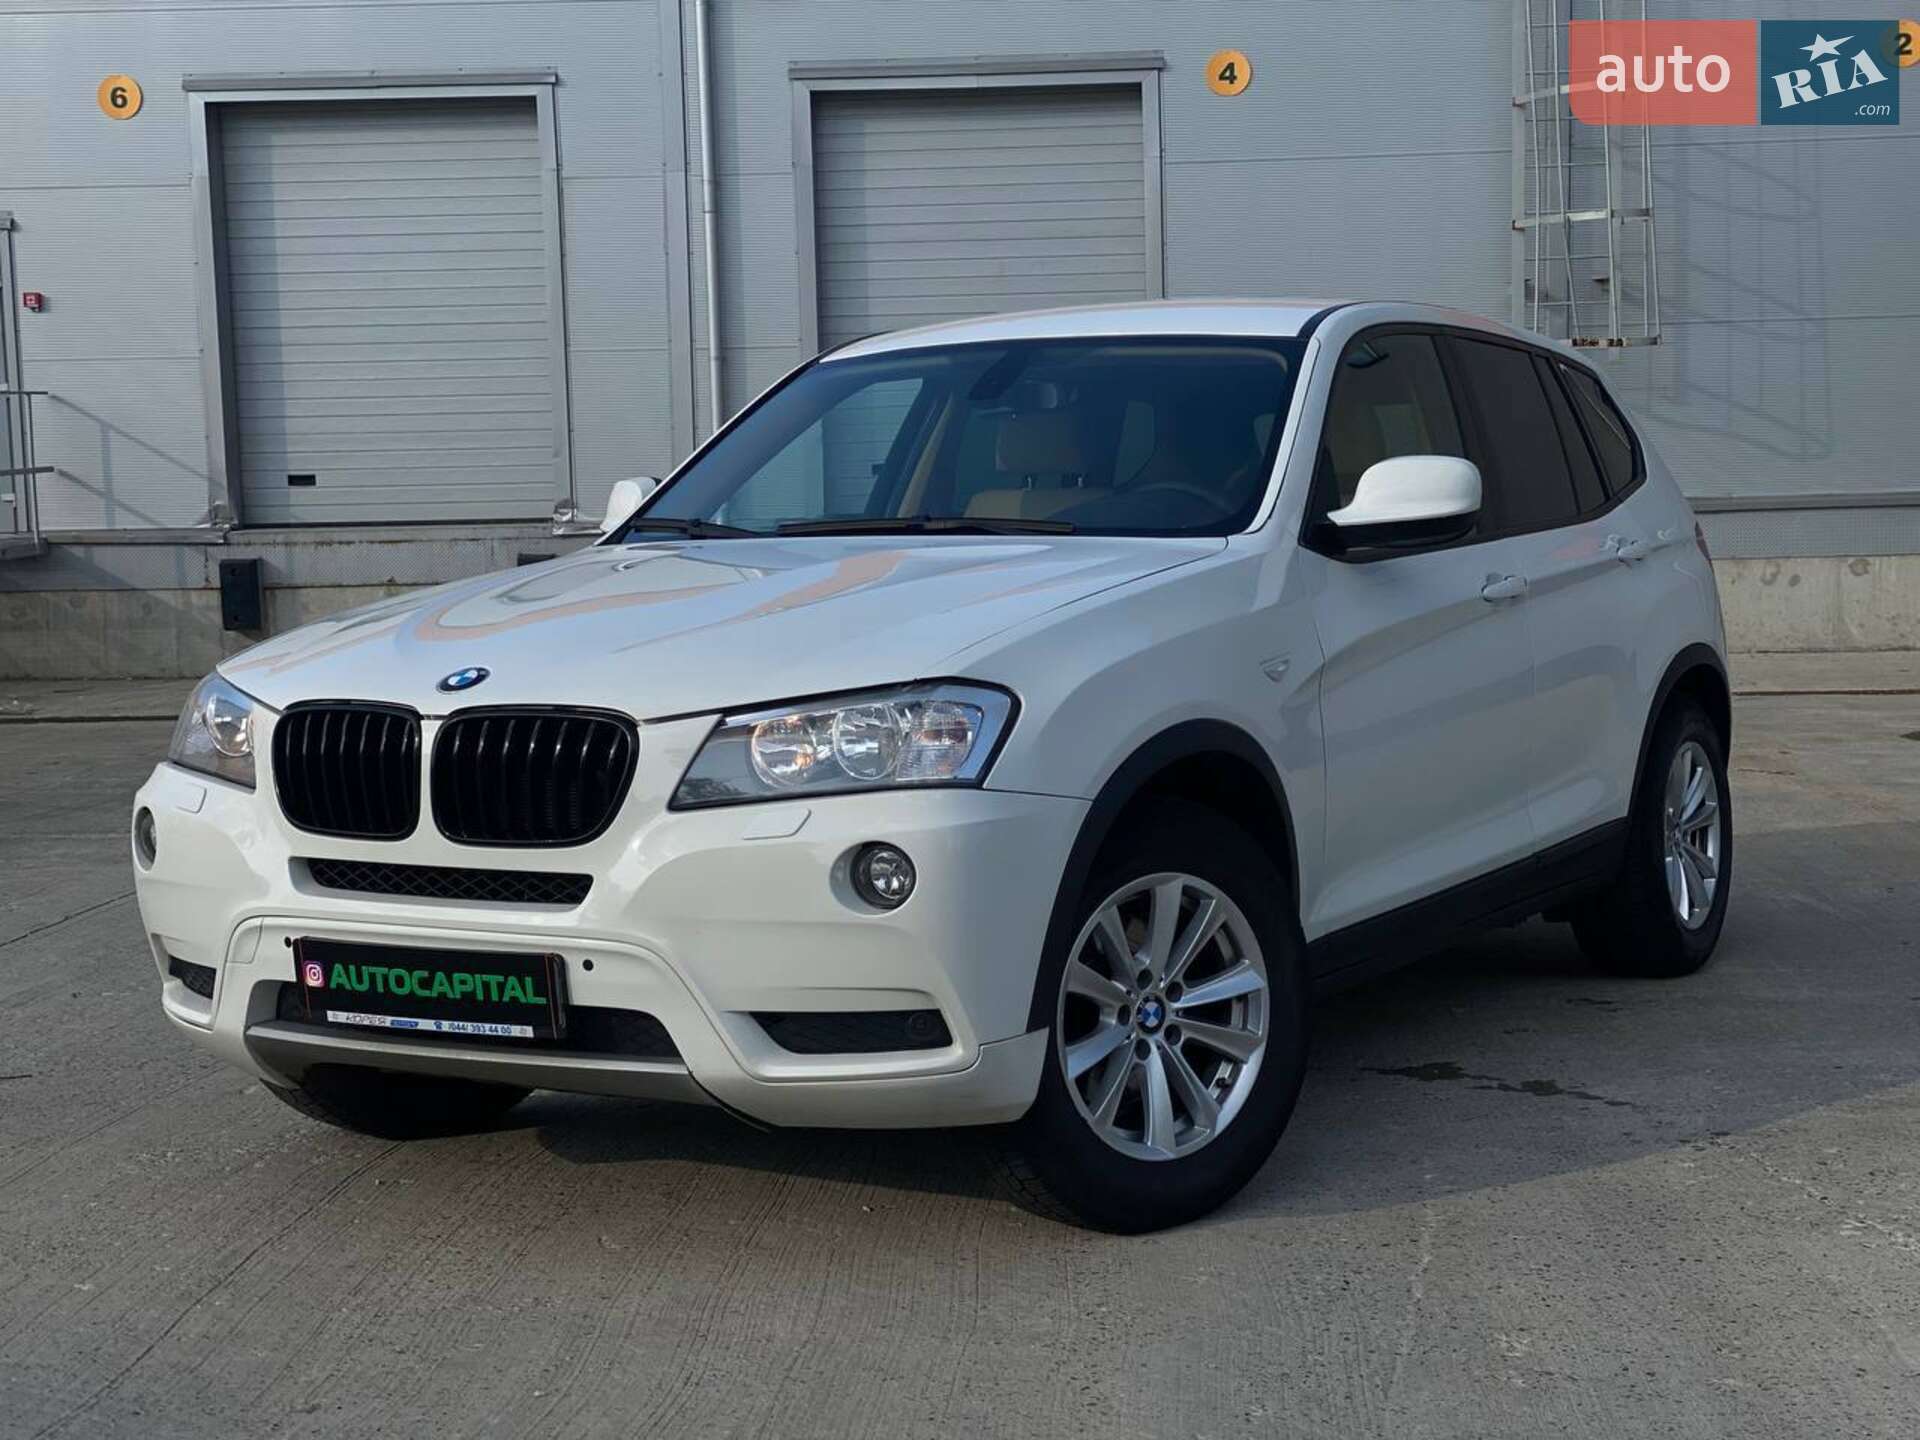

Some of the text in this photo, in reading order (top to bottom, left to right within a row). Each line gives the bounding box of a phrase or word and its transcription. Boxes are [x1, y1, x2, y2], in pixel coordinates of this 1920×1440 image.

[1894, 33, 1913, 56] 2
[1219, 62, 1237, 85] 4
[110, 86, 128, 109] 6
[329, 962, 547, 1005] AUTOCAPITAL
